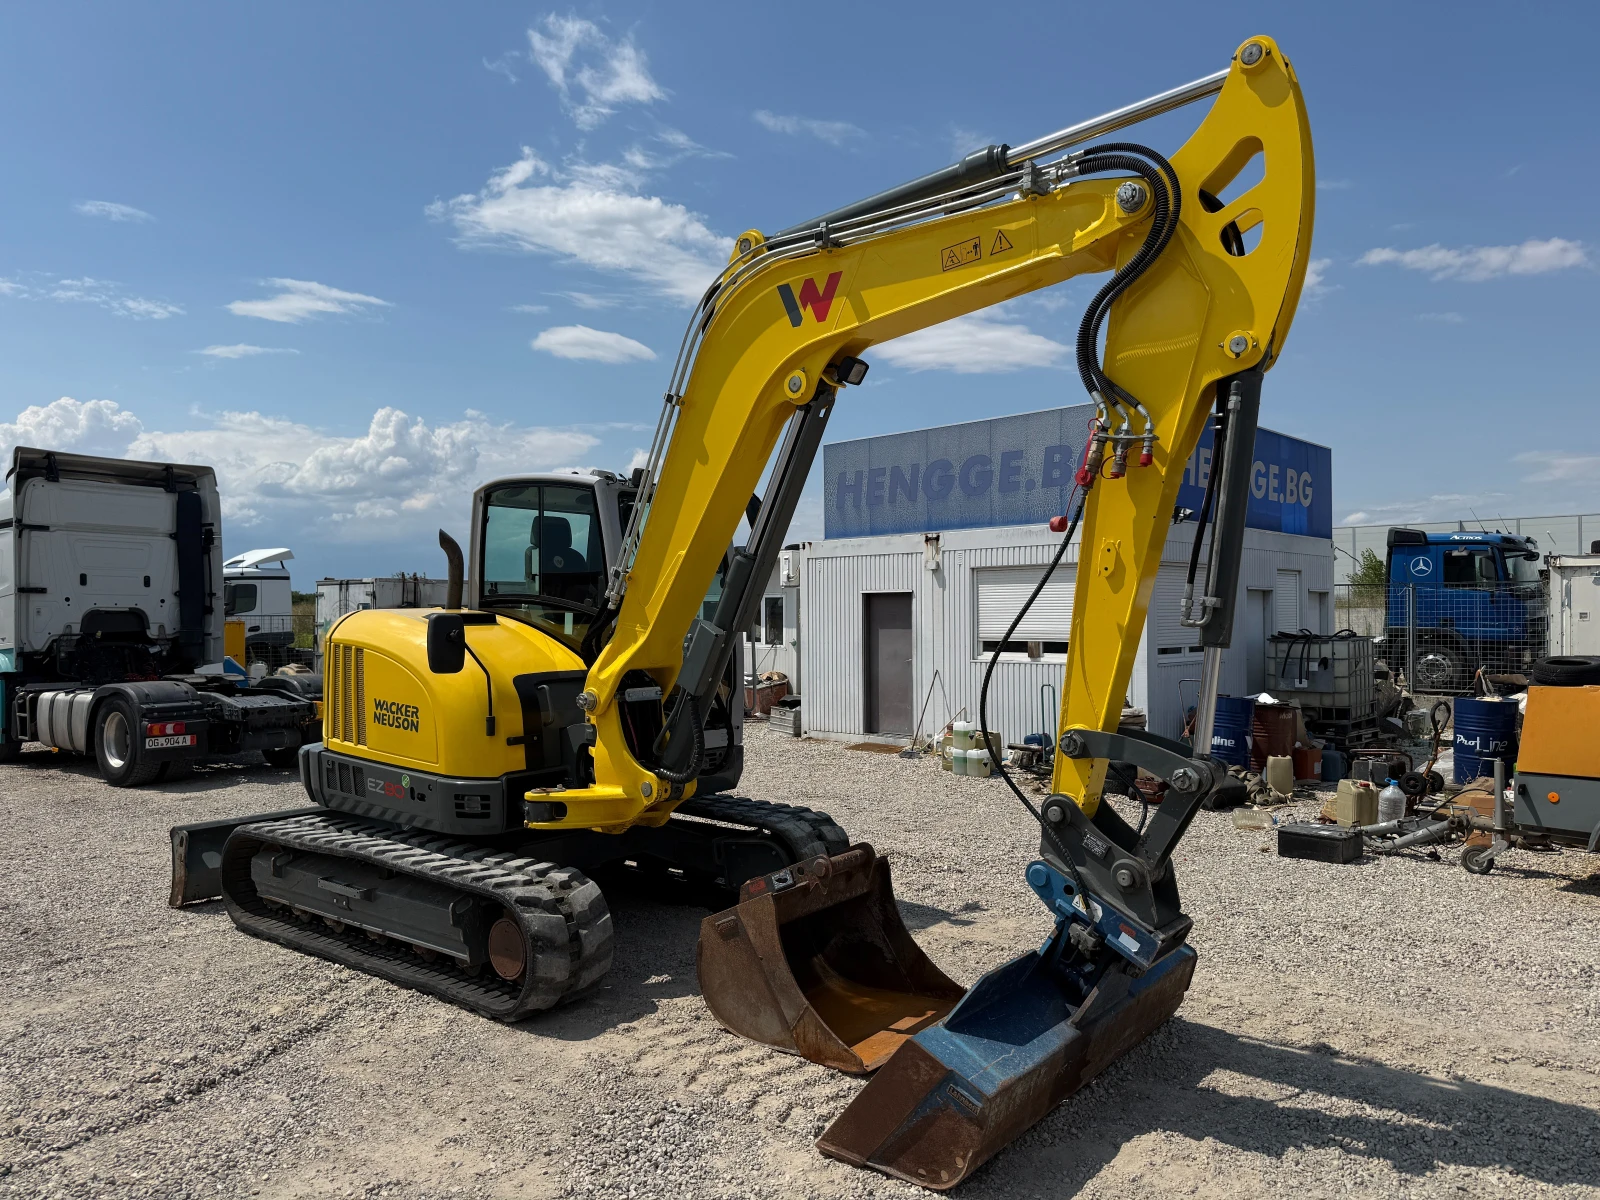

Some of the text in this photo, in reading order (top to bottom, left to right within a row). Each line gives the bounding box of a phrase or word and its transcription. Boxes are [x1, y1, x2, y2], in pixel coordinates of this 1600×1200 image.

[836, 445, 1087, 509] HENGGE.B
[373, 698, 420, 720] WACKER
[373, 711, 419, 733] NEUSON
[147, 738, 159, 747] OG
[164, 737, 180, 746] 904
[182, 736, 187, 744] A
[1211, 735, 1235, 747] line
[367, 777, 405, 799] EZ80
